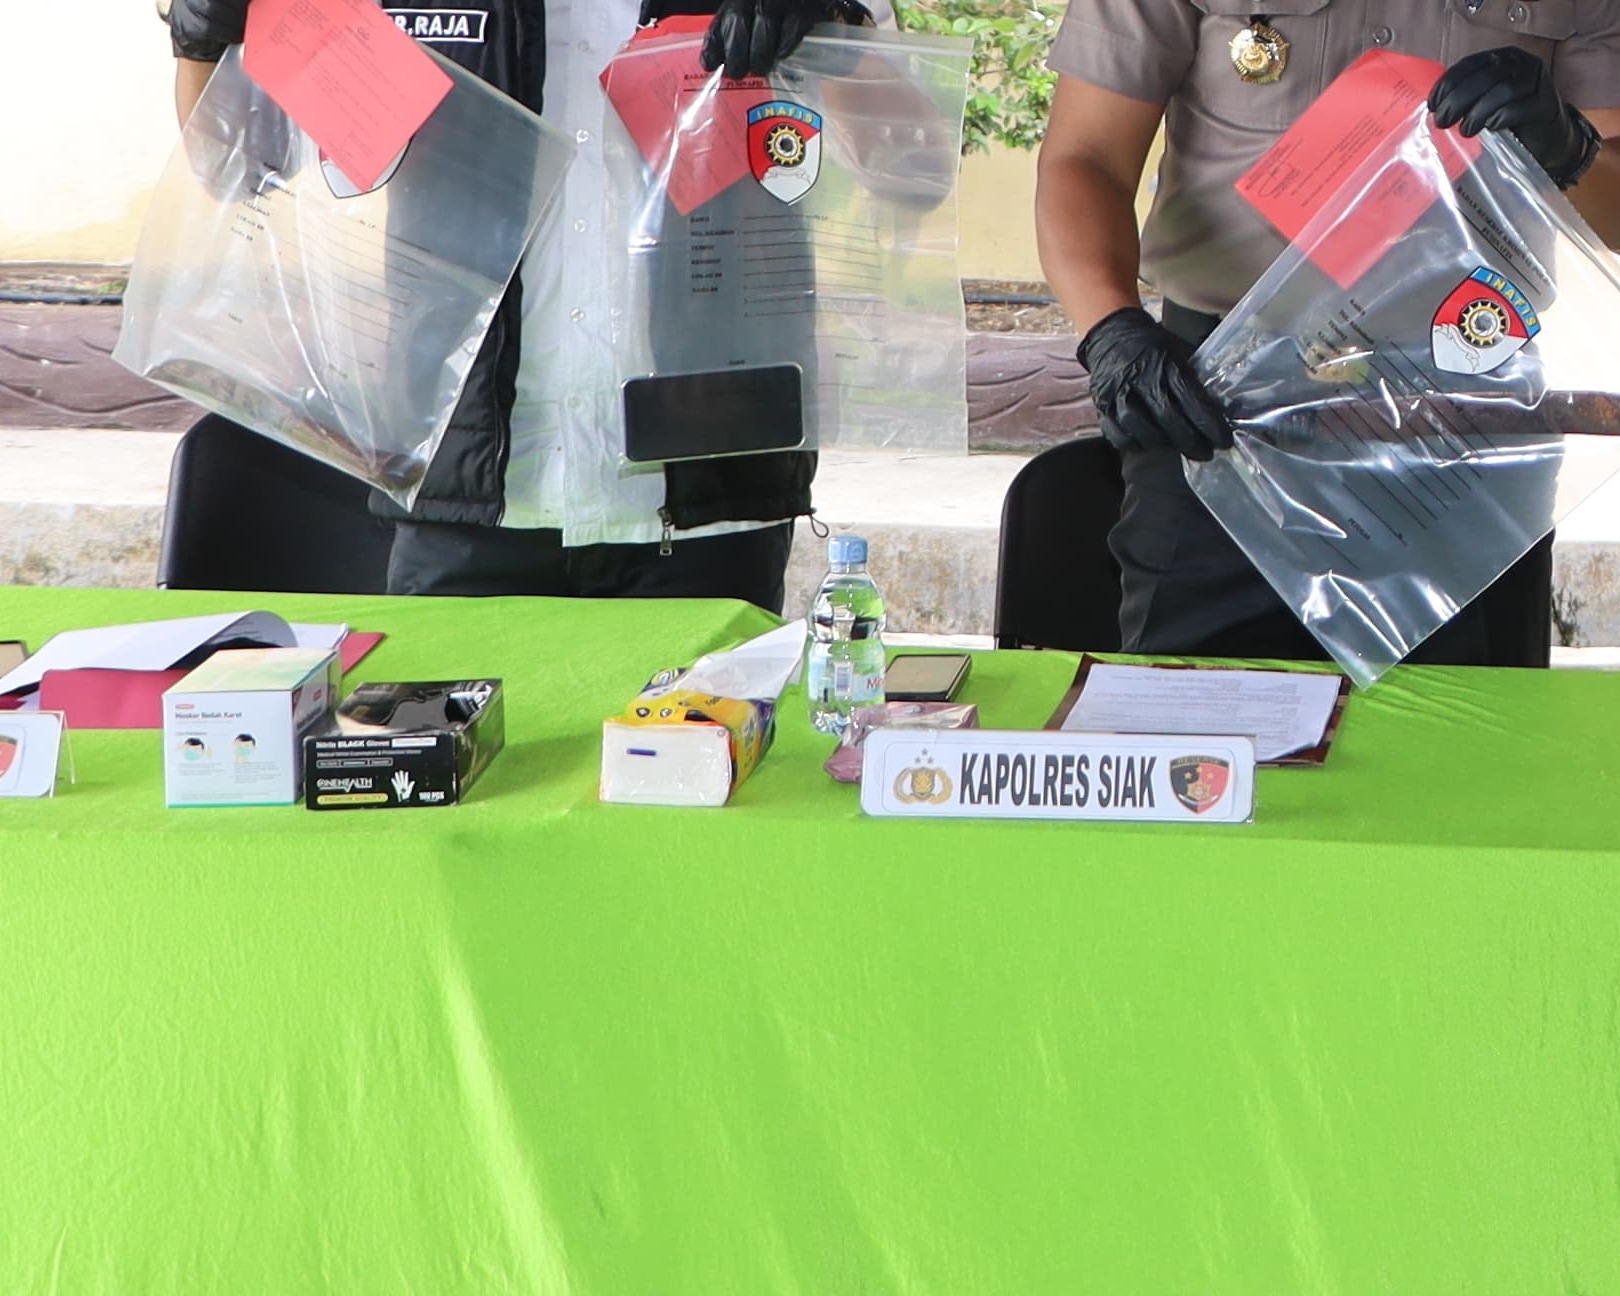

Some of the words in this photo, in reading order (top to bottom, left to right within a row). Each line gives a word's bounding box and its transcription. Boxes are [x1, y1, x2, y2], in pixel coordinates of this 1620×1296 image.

[391, 14, 469, 36] R.RAJA
[757, 105, 814, 123] INAFIS
[1486, 271, 1538, 328] INAFIS
[959, 751, 1090, 808] KAPOLRES
[1098, 755, 1157, 809] SIAK
